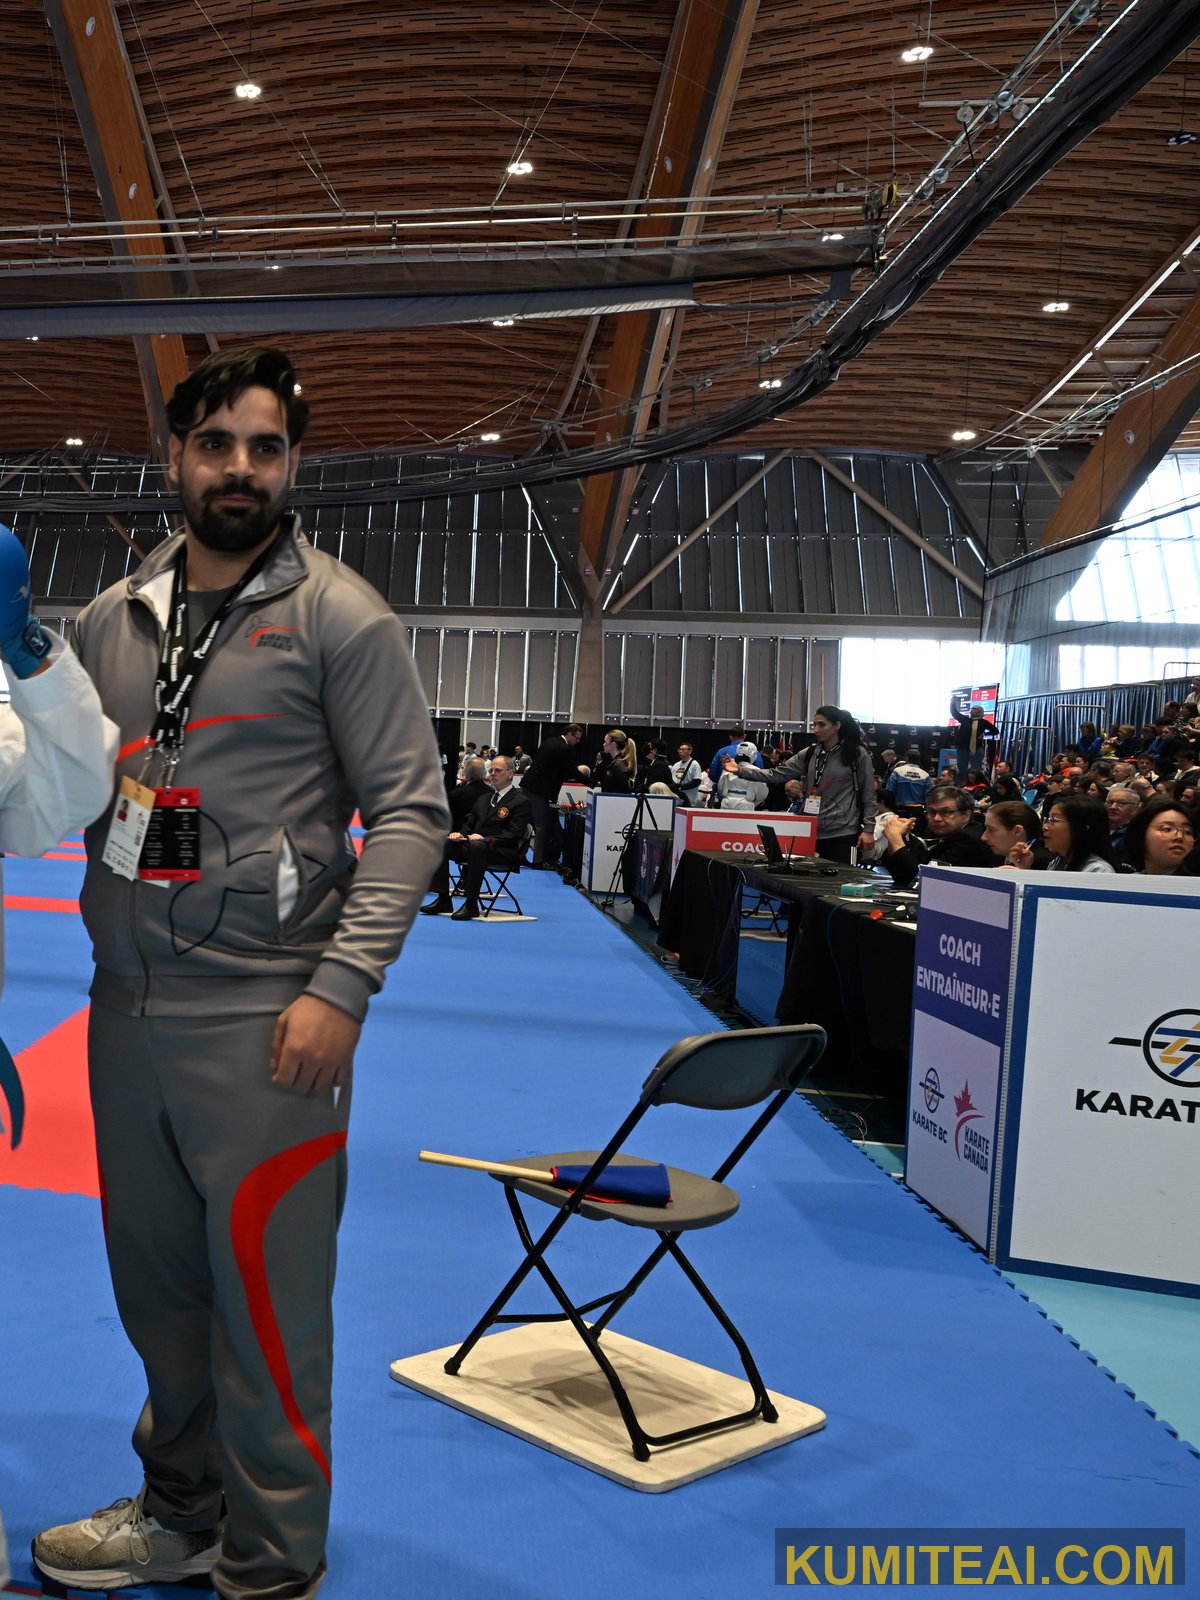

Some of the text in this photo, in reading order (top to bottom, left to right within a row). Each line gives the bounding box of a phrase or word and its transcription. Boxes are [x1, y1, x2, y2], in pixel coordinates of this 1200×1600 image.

[721, 841, 766, 856] COAC
[939, 933, 981, 967] COACH
[912, 1109, 948, 1144] KARATE BC
[964, 1125, 990, 1156] KARATE
[963, 1143, 989, 1175] CANADA
